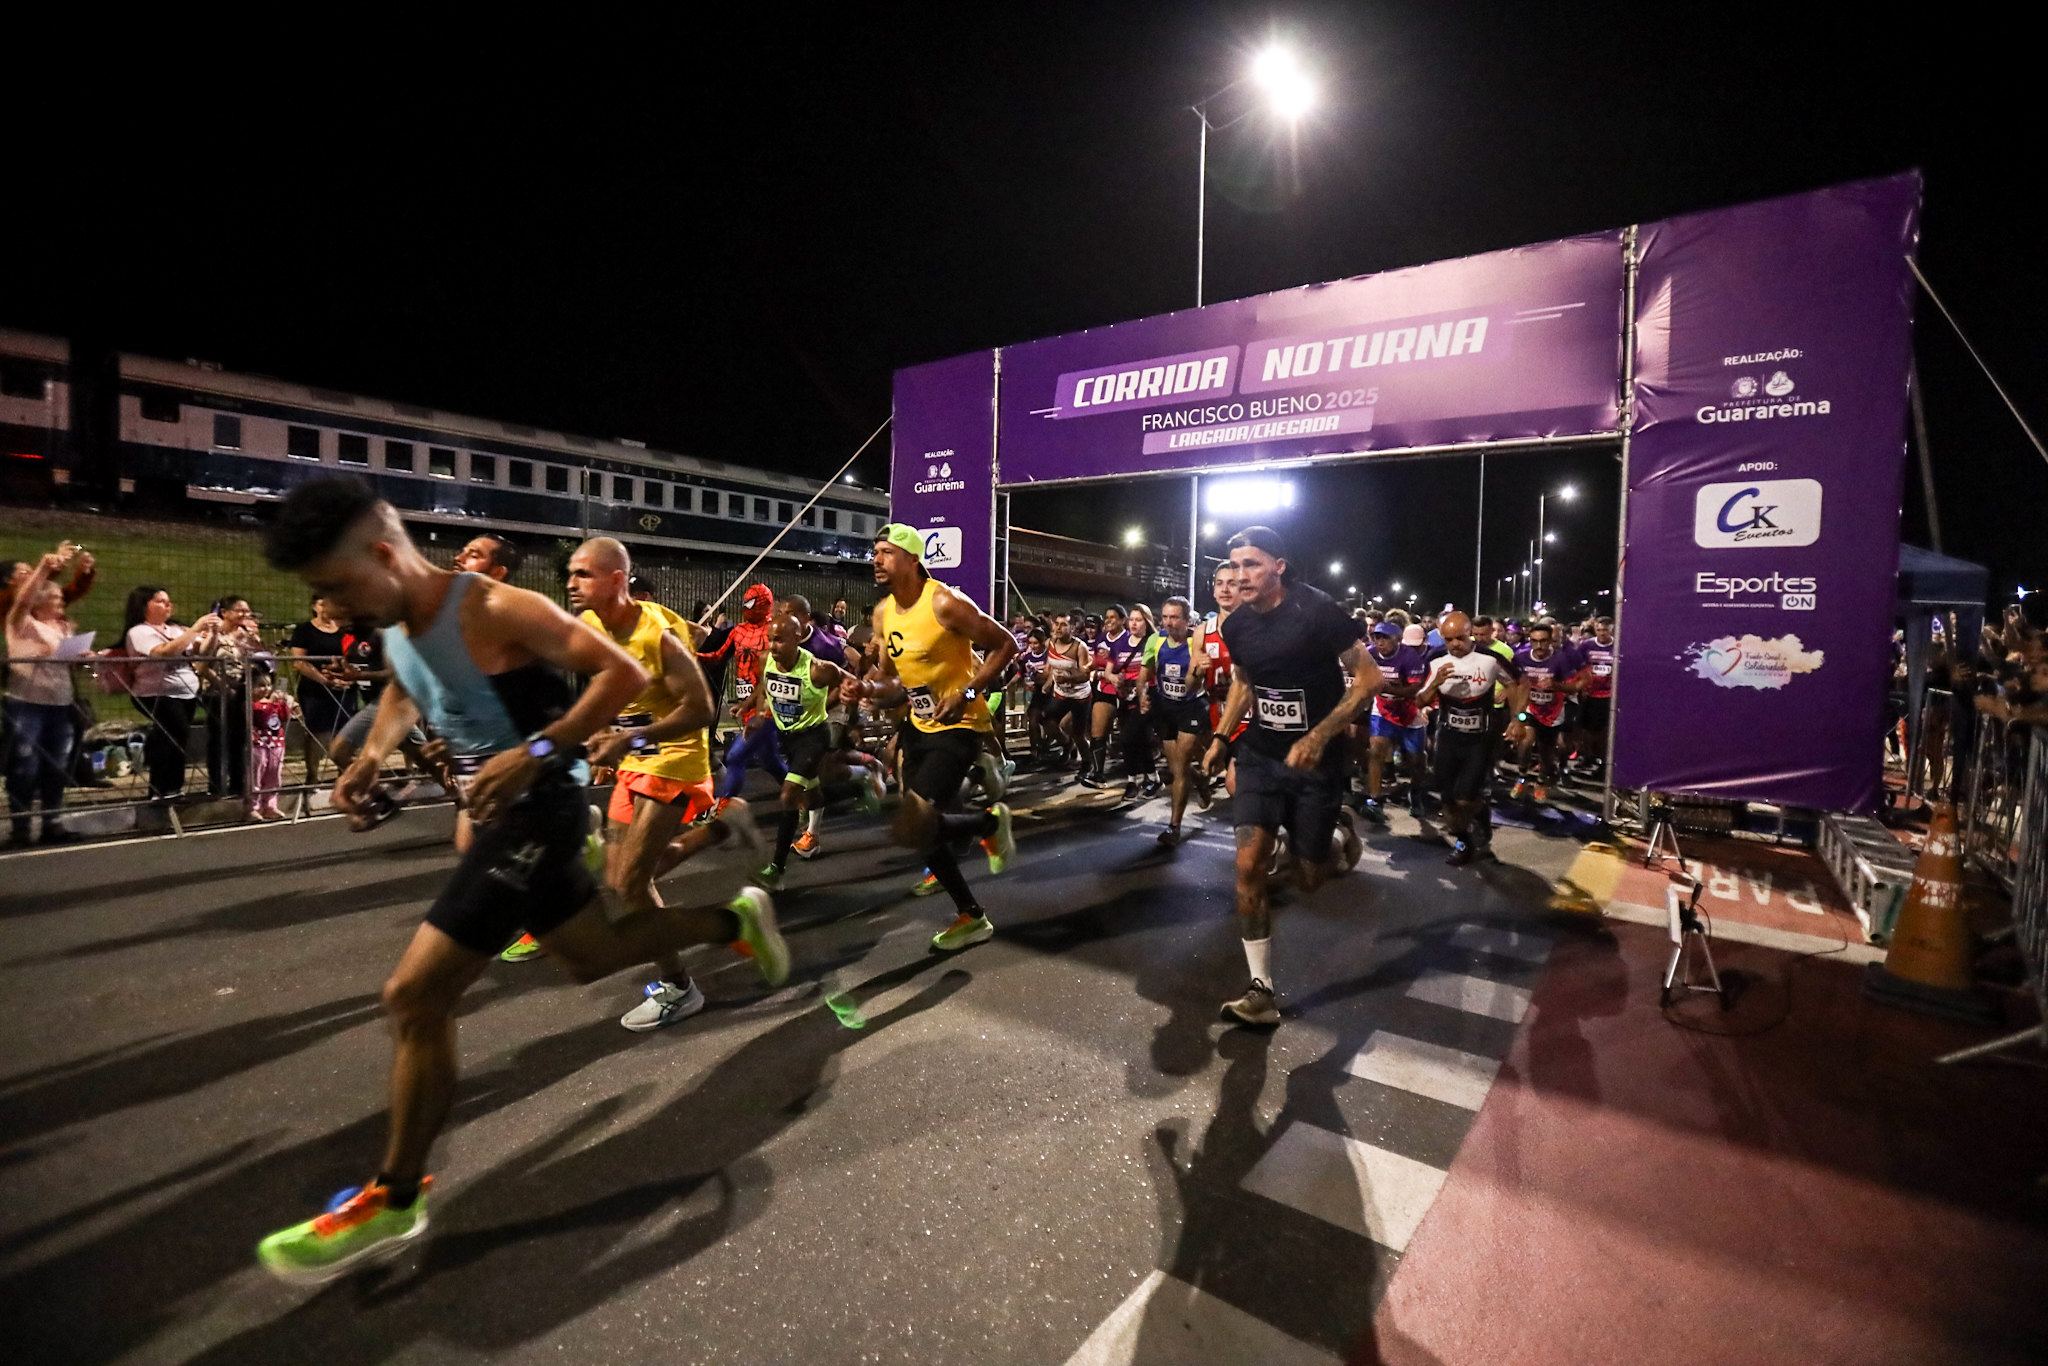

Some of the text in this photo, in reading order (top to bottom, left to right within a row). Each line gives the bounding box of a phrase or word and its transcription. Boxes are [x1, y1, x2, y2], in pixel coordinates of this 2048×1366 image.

[1073, 316, 1489, 408] CORRIDA NOTURNA
[1724, 348, 1804, 366] REALIZAÇÃO:
[1142, 387, 1379, 431] FRANCISCO BUENO 2025
[1696, 399, 1831, 425] Guararema
[1169, 414, 1340, 449] LARGADA/CHEGADA
[590, 458, 707, 485] PAULISTA
[1738, 461, 1778, 472] APOIO:
[914, 480, 965, 494] Guararema
[1717, 487, 1779, 533] CK
[1733, 528, 1794, 542] Eventos
[1696, 571, 1817, 600] Esportes
[770, 682, 796, 696] 0331
[1164, 684, 1186, 693] 0388
[1261, 701, 1297, 717] 0686
[1451, 716, 1477, 725] 0987
